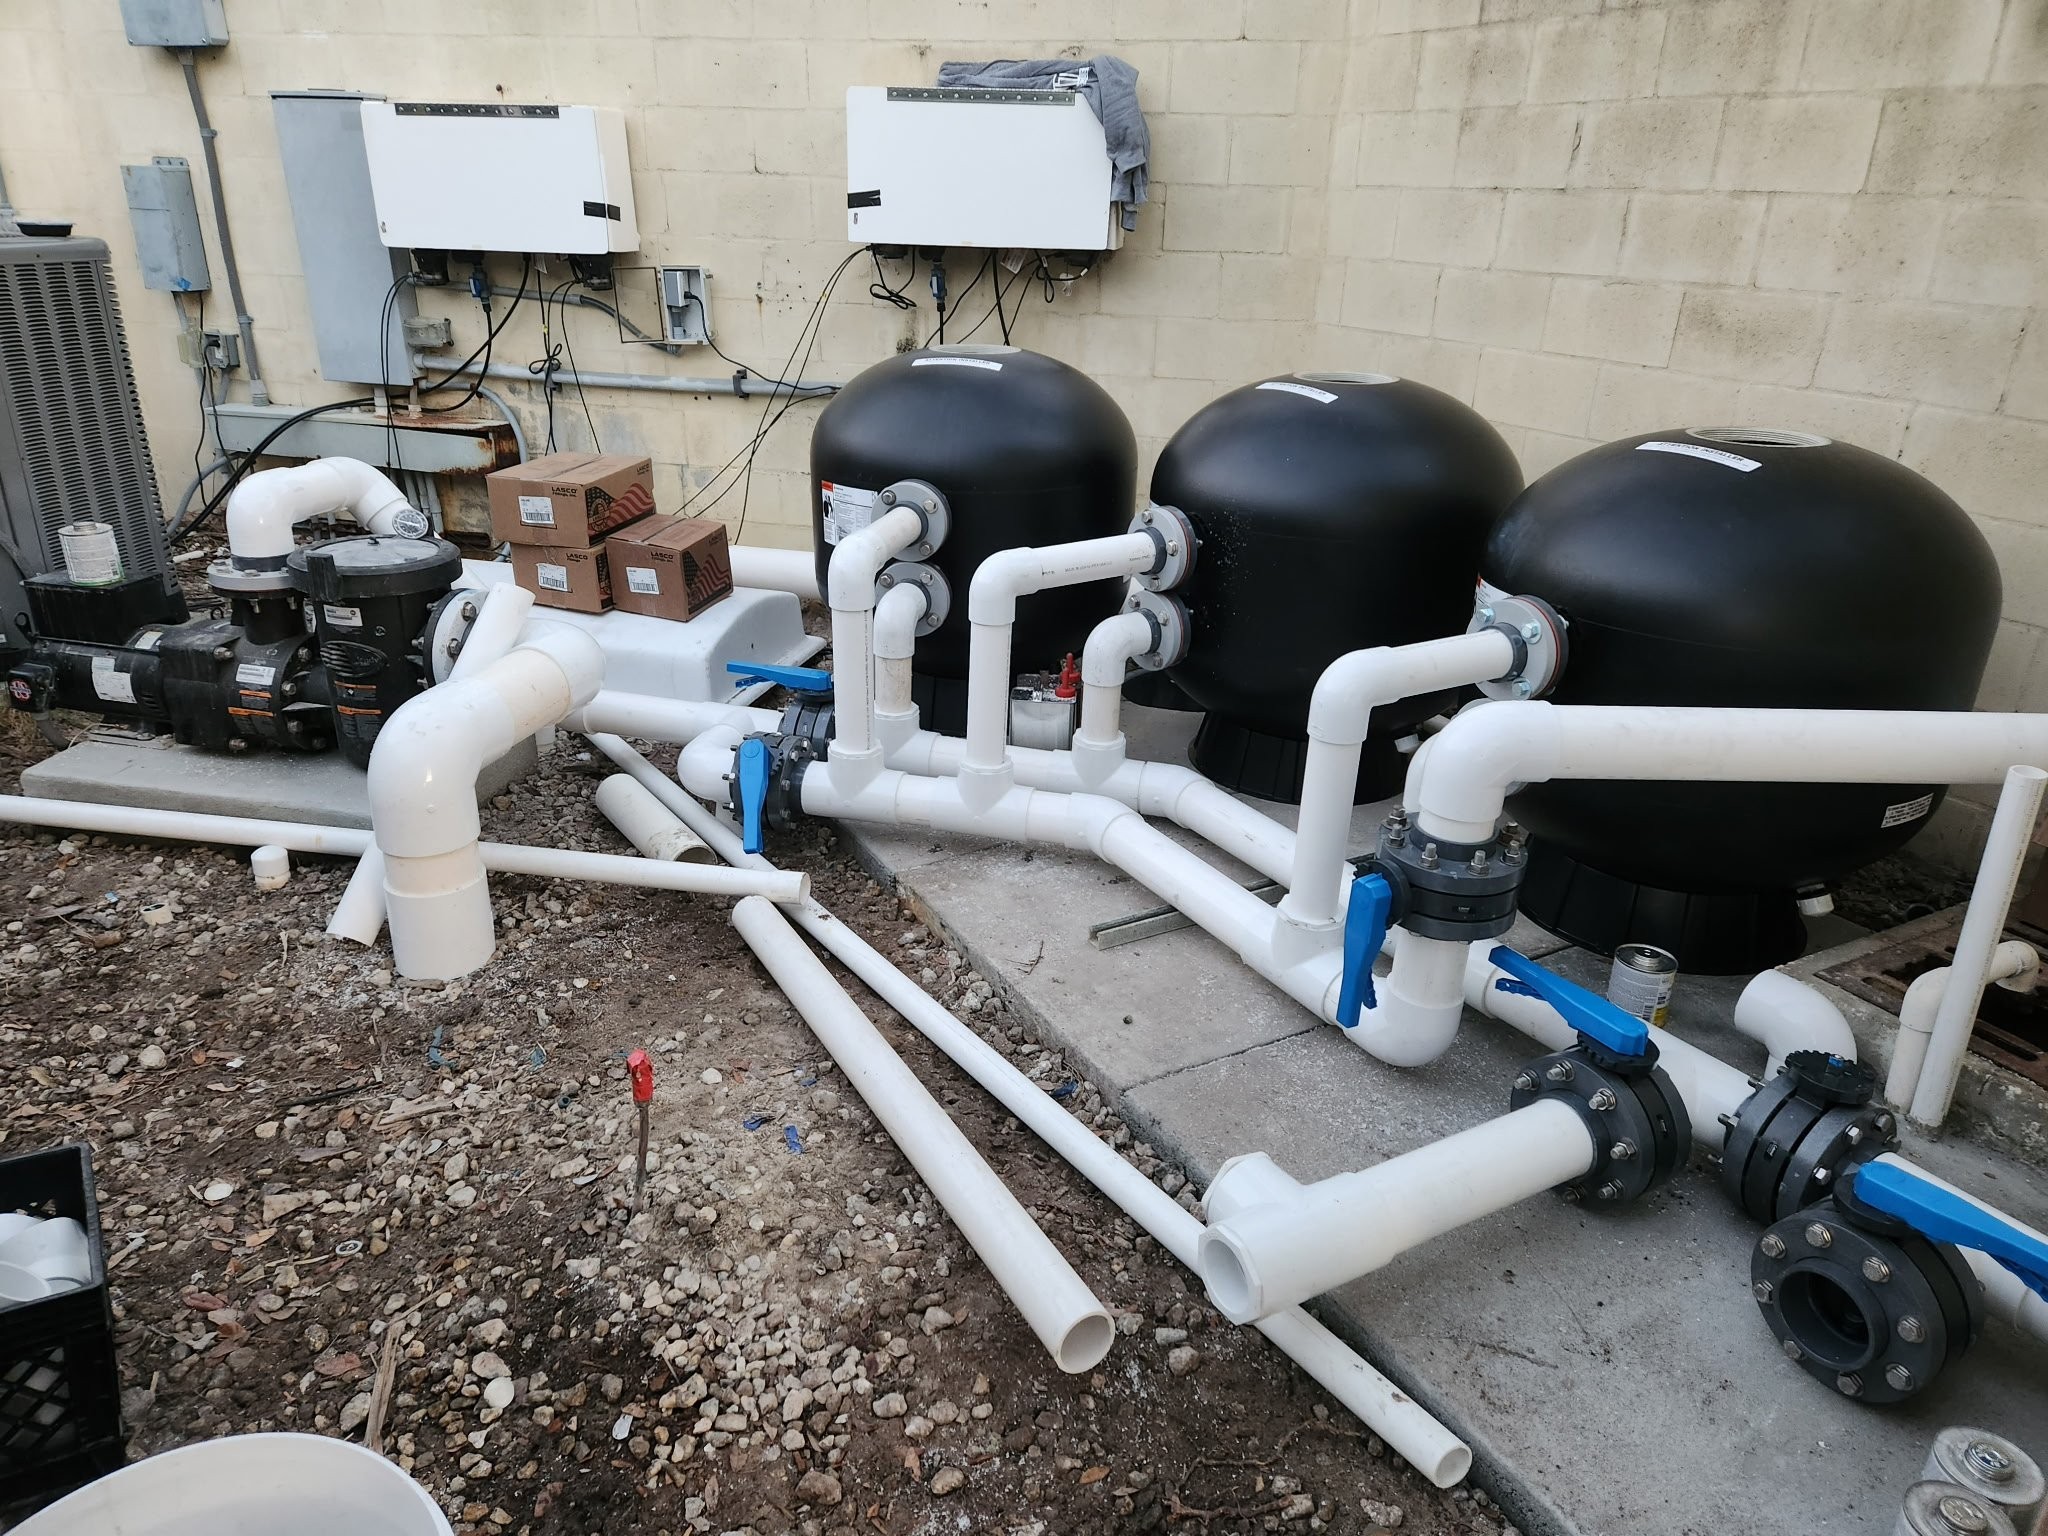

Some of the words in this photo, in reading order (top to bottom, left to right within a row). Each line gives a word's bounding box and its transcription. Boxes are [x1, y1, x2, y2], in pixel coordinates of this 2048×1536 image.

[1701, 446, 1745, 462] INSTALLER
[551, 486, 577, 494] LASCO
[565, 552, 588, 560] LASCO
[650, 551, 674, 560] LASCO
